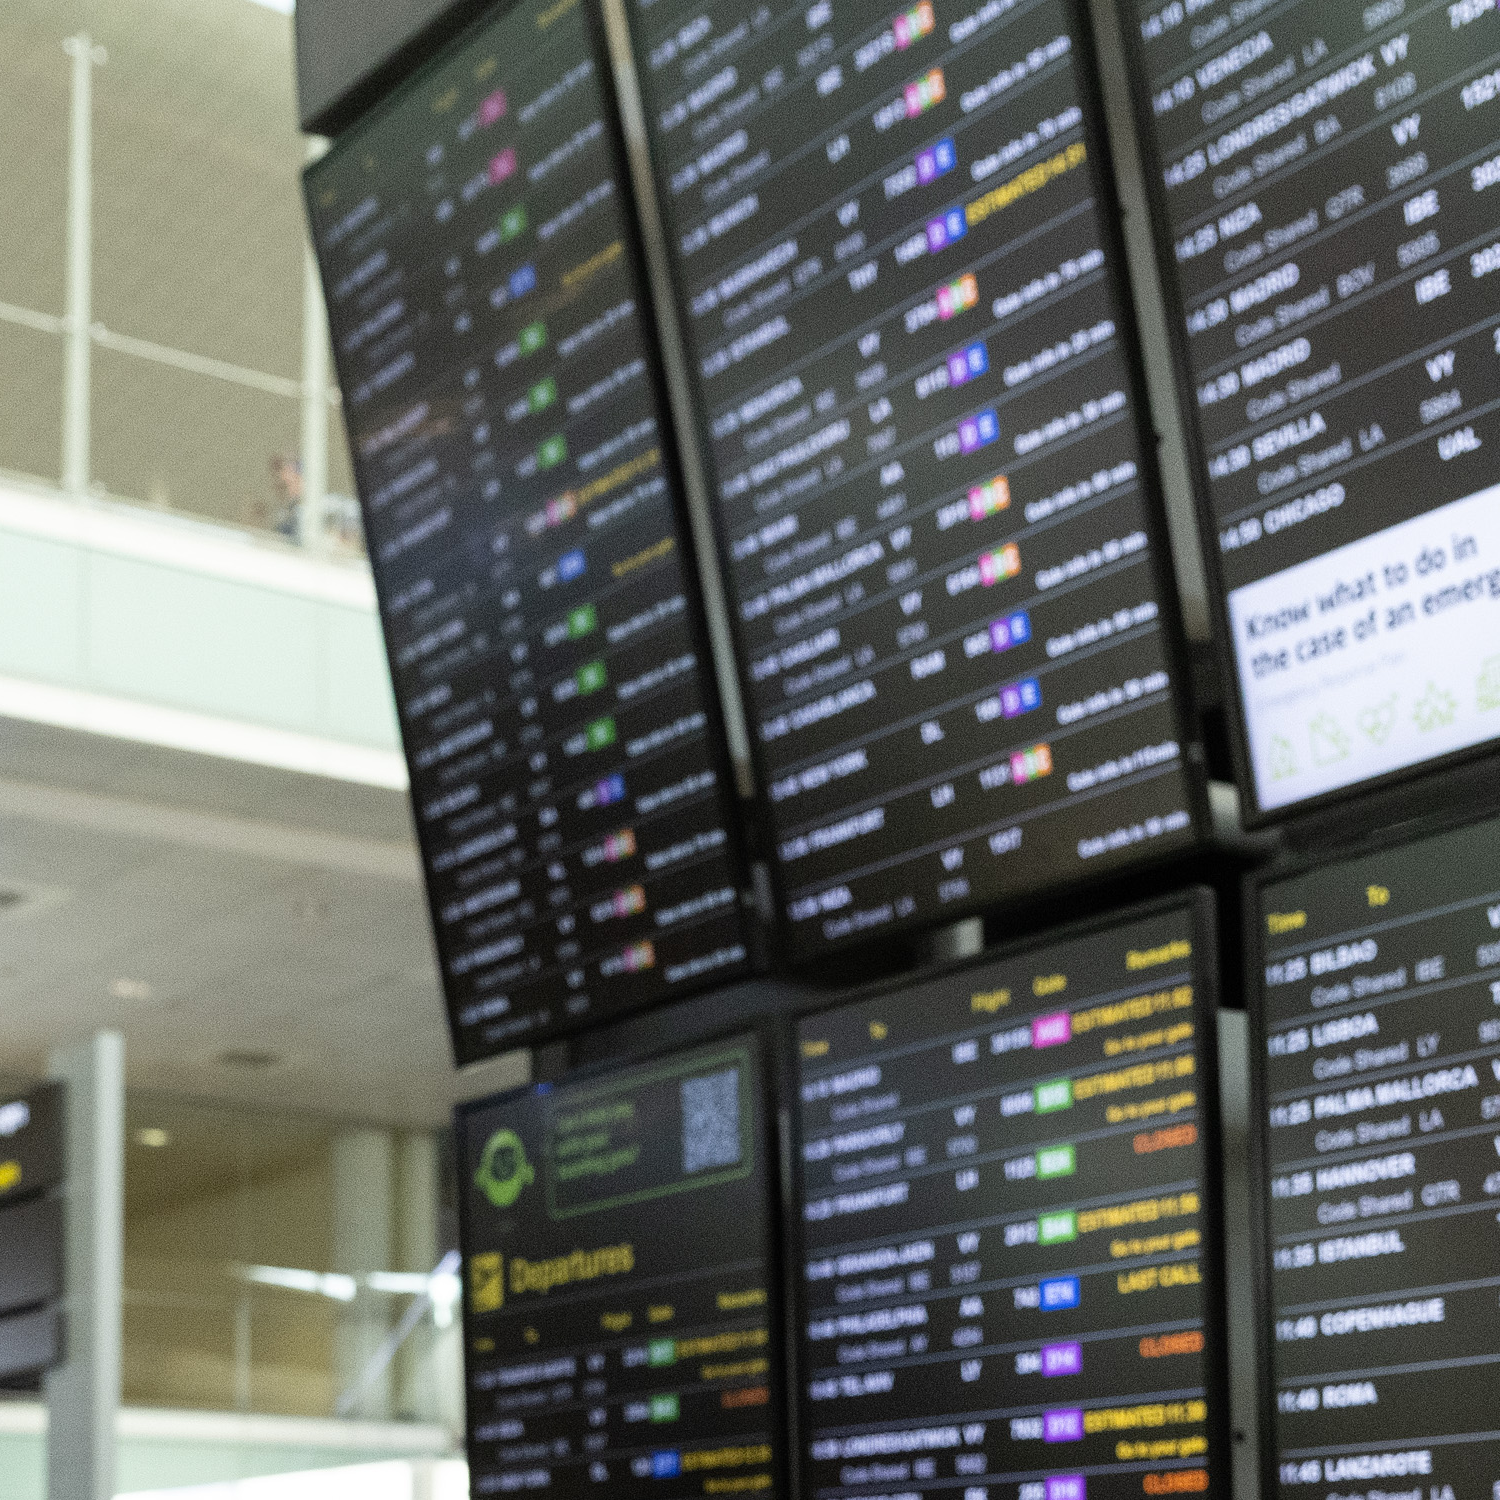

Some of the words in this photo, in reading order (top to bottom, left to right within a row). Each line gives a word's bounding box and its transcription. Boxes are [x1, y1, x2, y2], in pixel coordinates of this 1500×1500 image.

[1425, 350, 1455, 381] VY
[1243, 603, 1310, 640] Know
[1315, 571, 1376, 614] what
[1381, 561, 1409, 588] to
[1414, 547, 1446, 577] do
[1451, 534, 1478, 562] in
[1249, 648, 1289, 679] the
[1294, 626, 1346, 663] case
[1352, 608, 1377, 642] of
[1384, 600, 1415, 630] an
